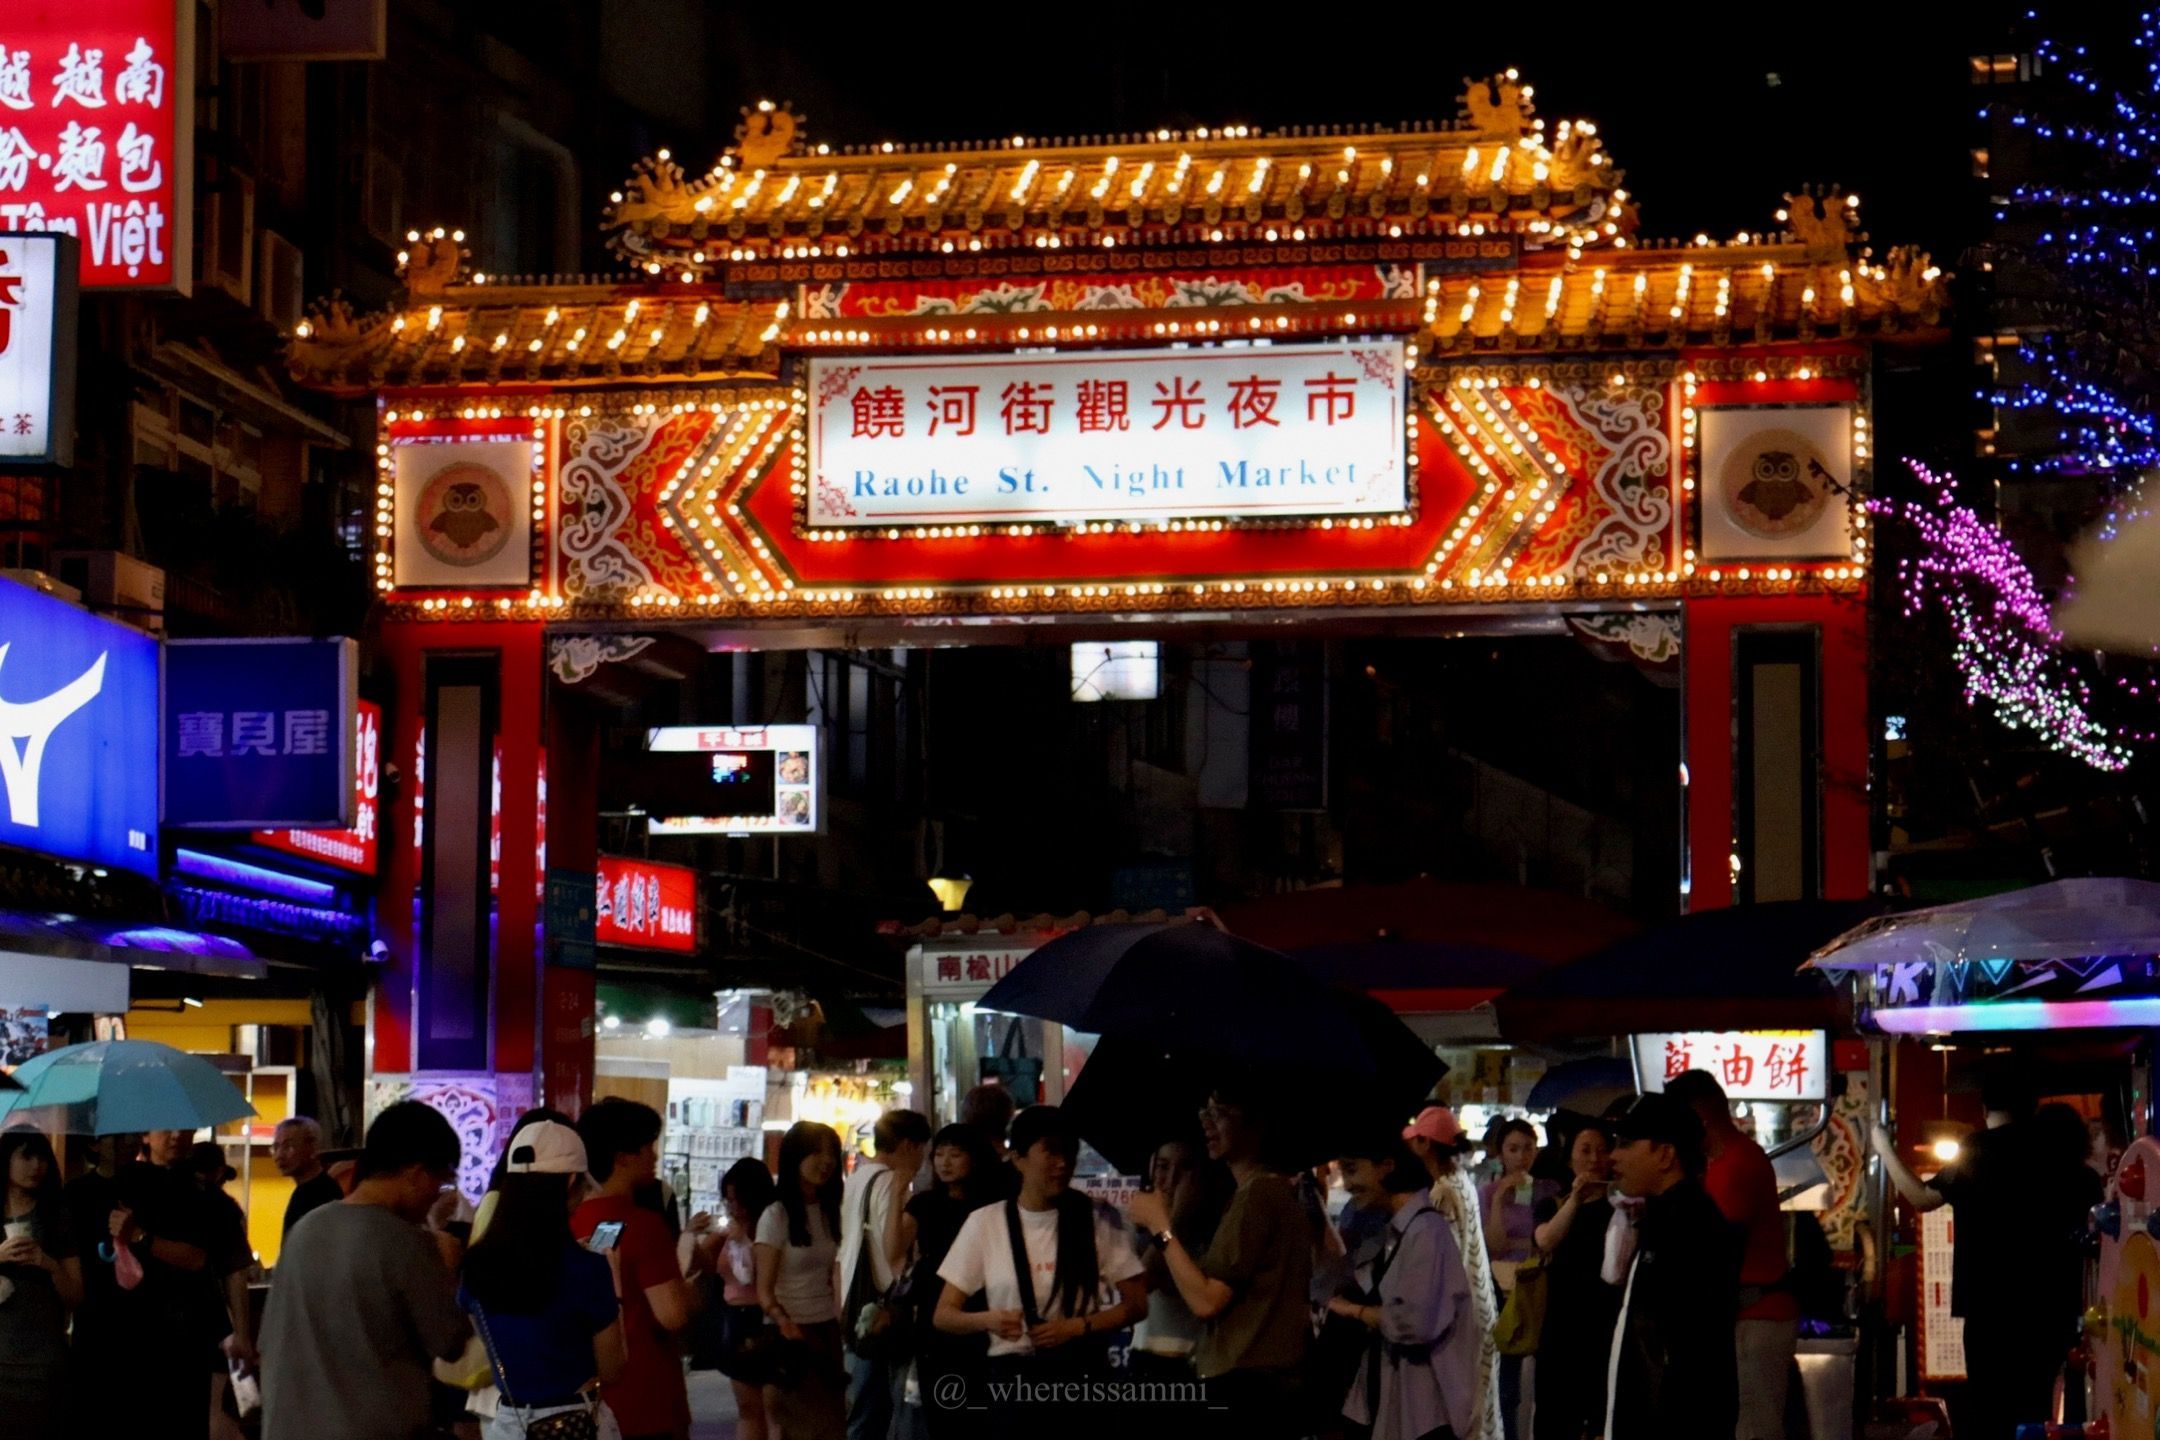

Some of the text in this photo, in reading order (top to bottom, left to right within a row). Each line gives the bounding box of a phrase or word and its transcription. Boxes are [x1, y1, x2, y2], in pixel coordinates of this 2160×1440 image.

[86, 200, 164, 278] Việt
[851, 371, 1358, 439] 饒河街觀光夜市
[854, 459, 1356, 498] Raohe St. Night Market
[177, 709, 329, 757] 寶貝屋
